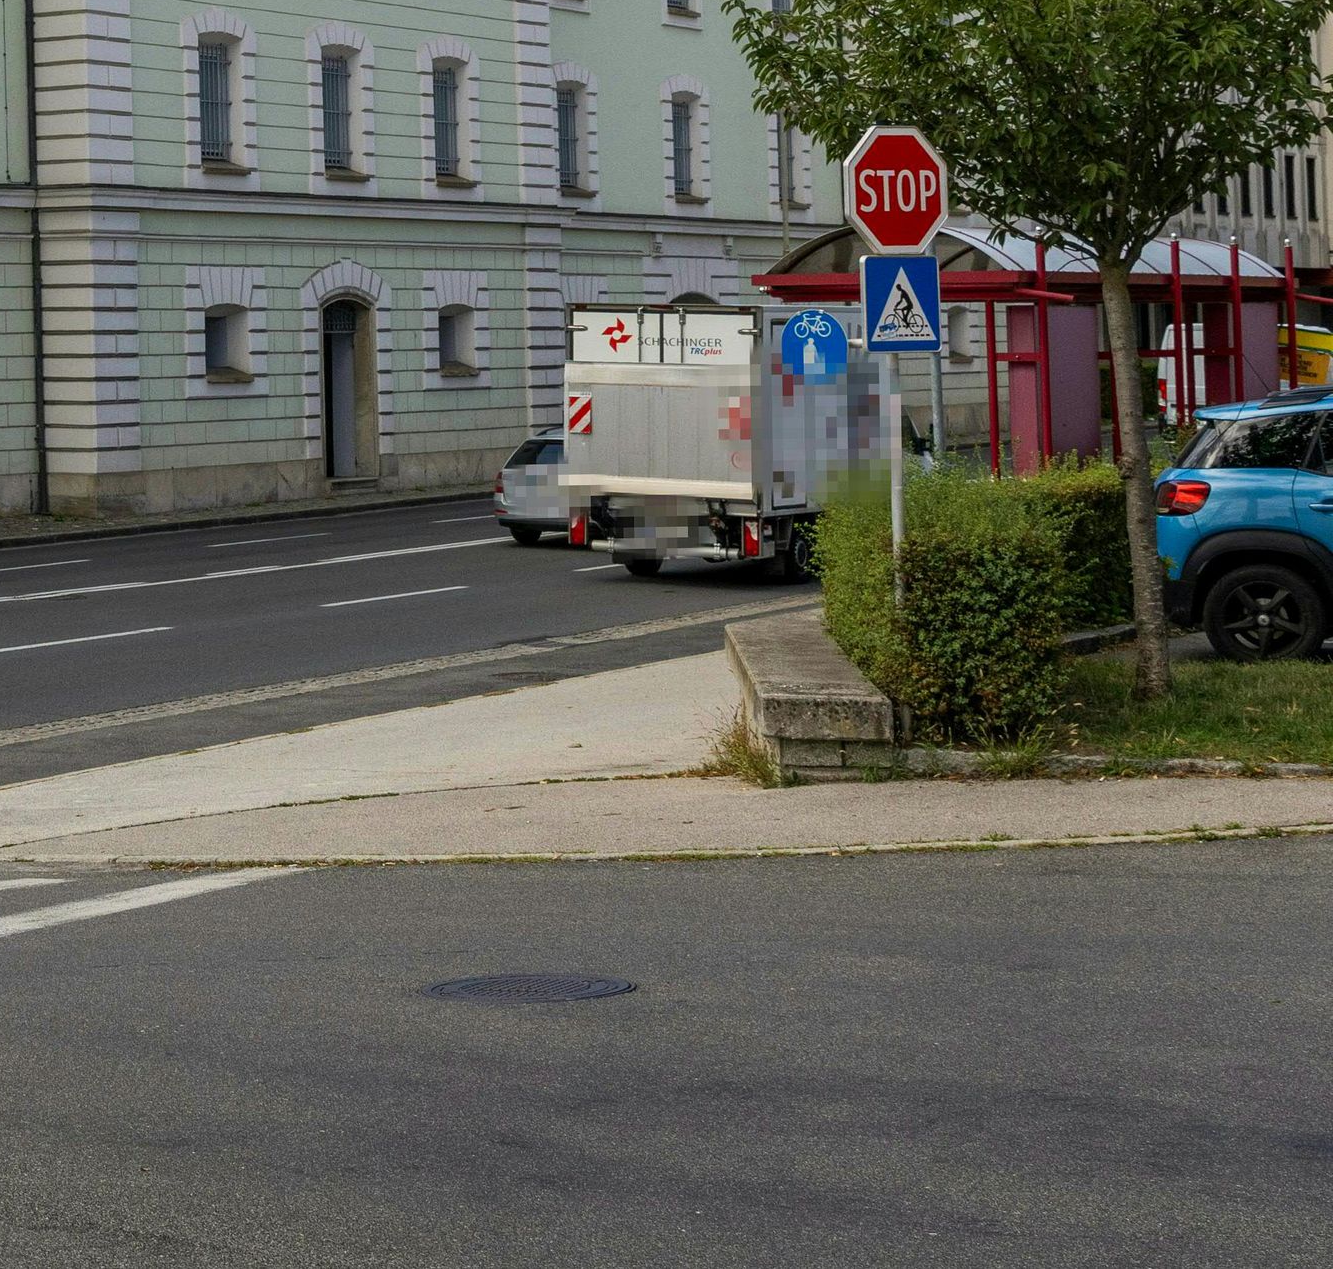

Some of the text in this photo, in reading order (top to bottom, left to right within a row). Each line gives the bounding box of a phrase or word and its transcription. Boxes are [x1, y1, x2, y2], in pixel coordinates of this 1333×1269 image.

[859, 169, 937, 213] STOP
[637, 337, 722, 347] SCHACHINGER
[690, 347, 722, 356] TRCplus
